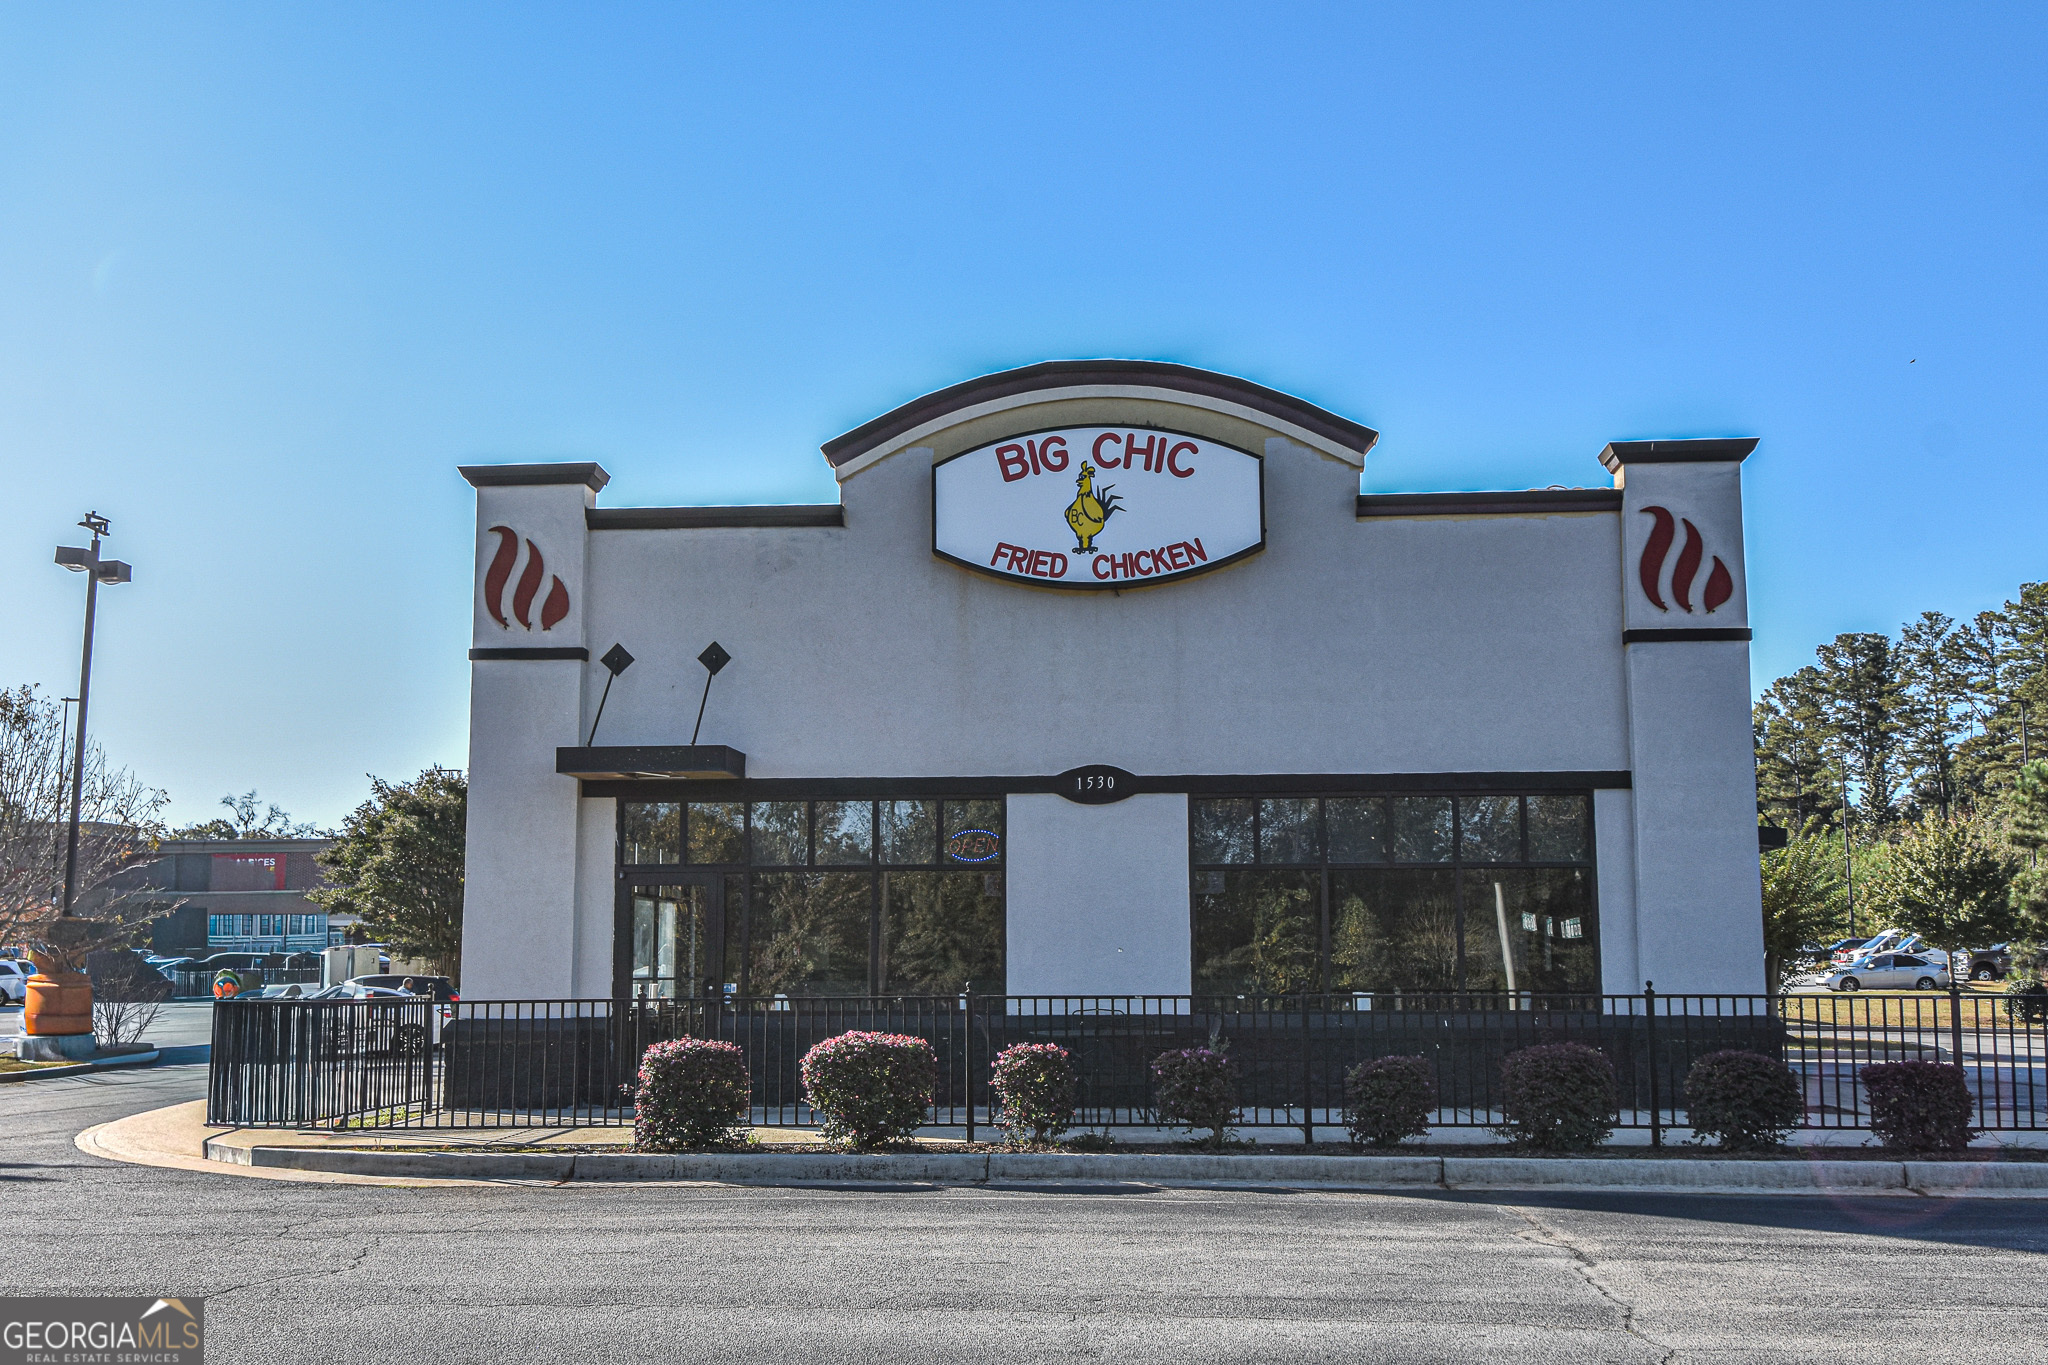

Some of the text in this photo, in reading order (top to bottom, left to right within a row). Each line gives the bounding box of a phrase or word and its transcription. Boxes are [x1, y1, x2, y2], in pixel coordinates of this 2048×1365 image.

[995, 432, 1199, 483] BIG CHIC
[1071, 508, 1084, 527] BC
[990, 537, 1208, 580] FRIED CHICKEN
[1077, 775, 1115, 790] 1530
[949, 837, 999, 854] OPEN
